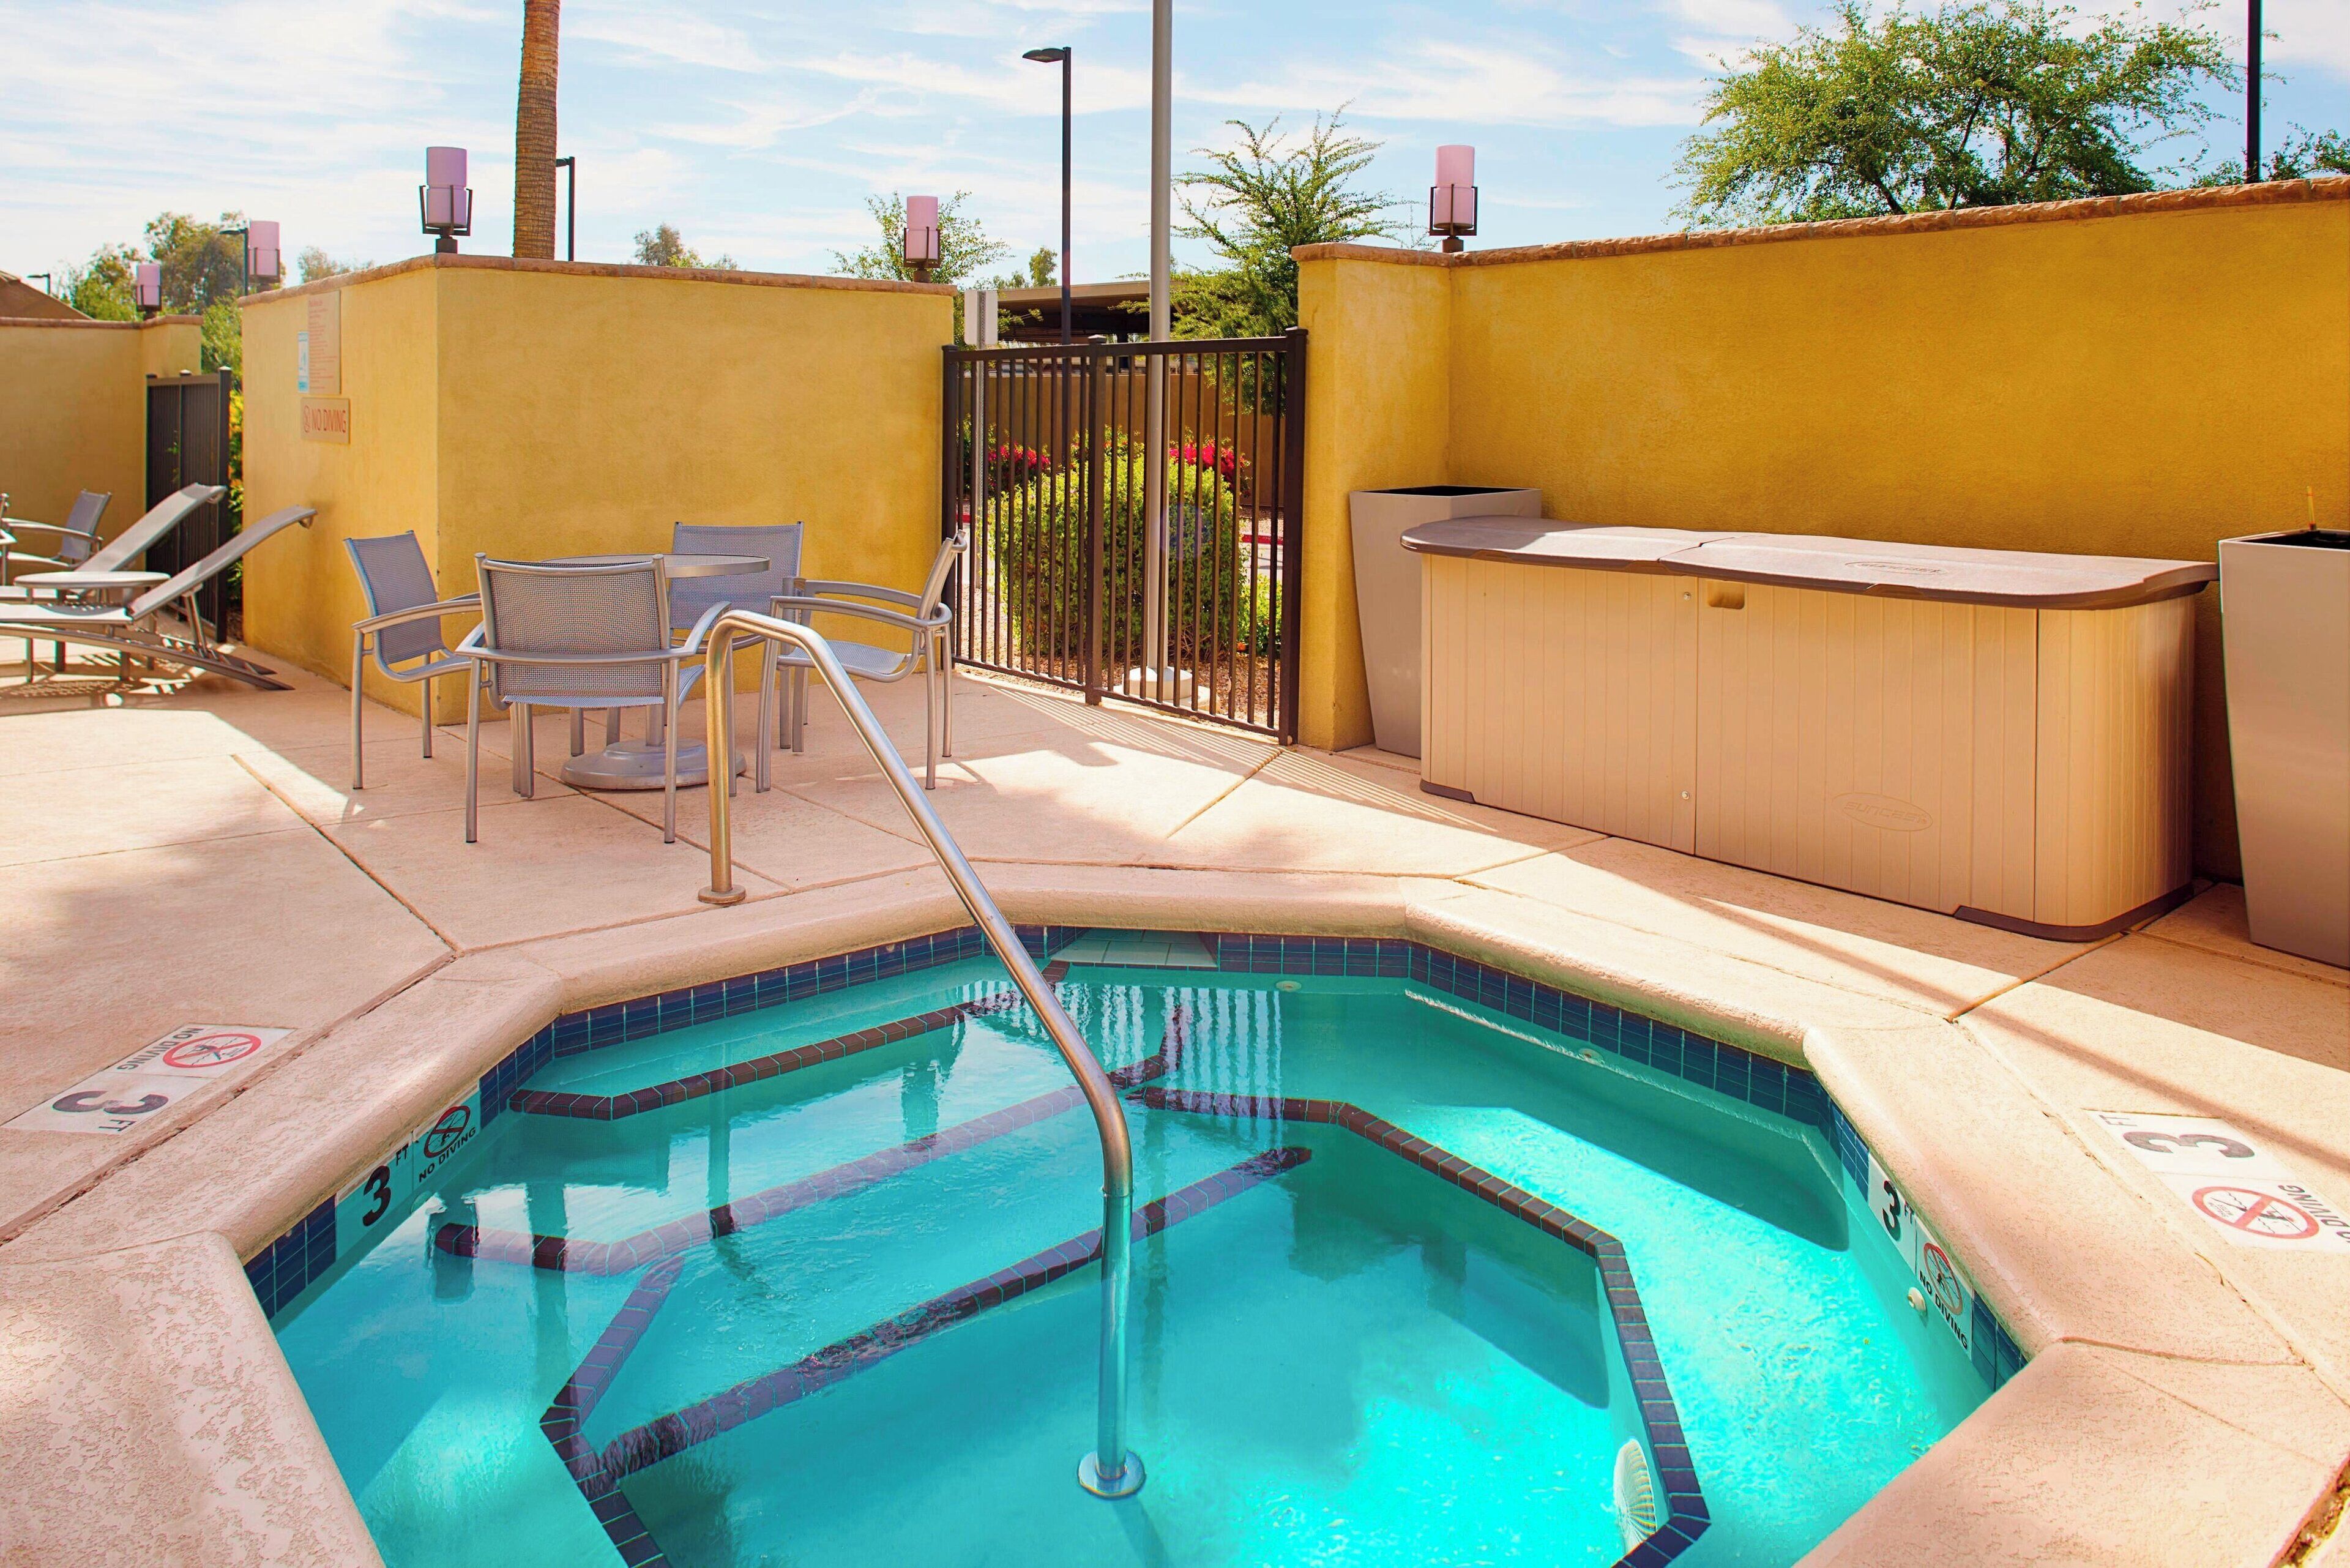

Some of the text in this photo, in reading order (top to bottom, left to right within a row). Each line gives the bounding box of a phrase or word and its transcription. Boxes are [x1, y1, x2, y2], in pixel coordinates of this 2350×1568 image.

[311, 409, 346, 433] NO DIVING
[116, 1027, 206, 1070] NO DIVING
[51, 1089, 170, 1132] 3 FT
[419, 1126, 476, 1183] NO DIVING
[2098, 1114, 2255, 1159] 3 FT
[362, 1143, 409, 1226] 3 FT
[1882, 1180, 1914, 1242] 3 FT
[1919, 1270, 1933, 1295] NO
[1934, 1293, 1968, 1350] DIVING
